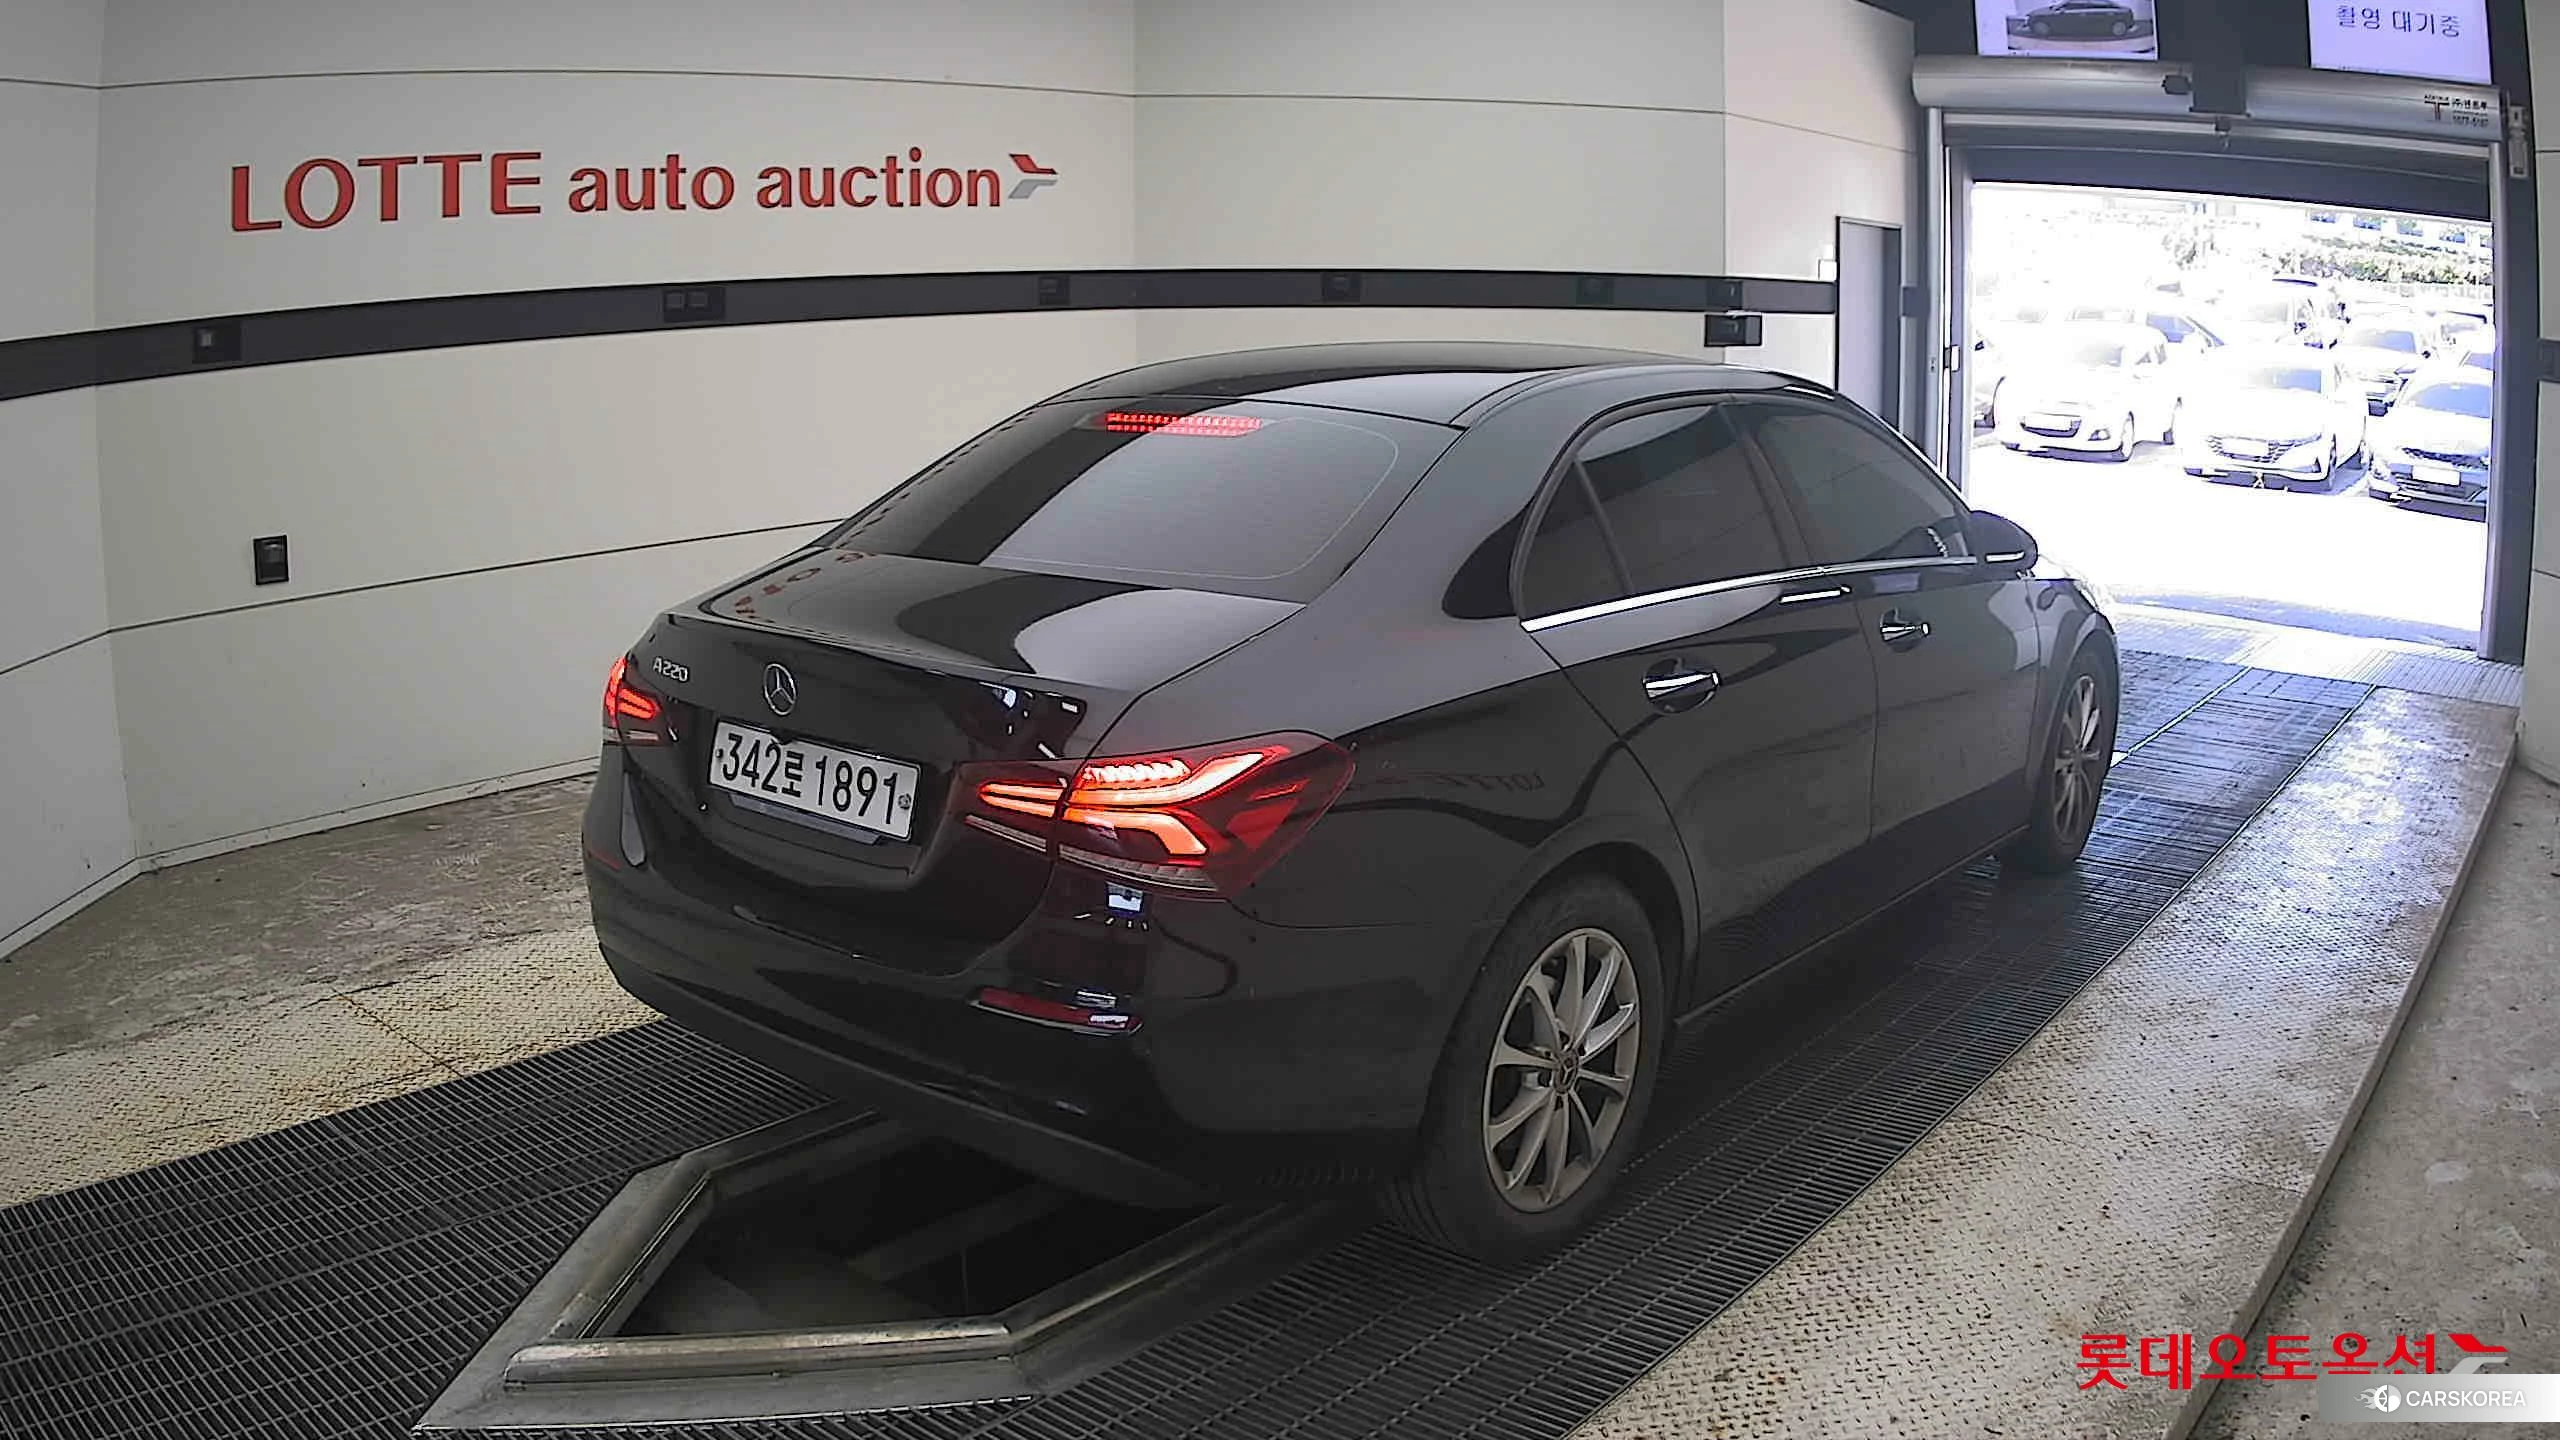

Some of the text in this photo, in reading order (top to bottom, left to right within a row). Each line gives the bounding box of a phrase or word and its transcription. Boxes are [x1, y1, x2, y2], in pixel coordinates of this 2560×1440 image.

[2392, 10, 2460, 38] 대기중
[231, 147, 1001, 232] LOTTE auto auction
[653, 656, 688, 682] A220
[815, 755, 899, 825] 1891
